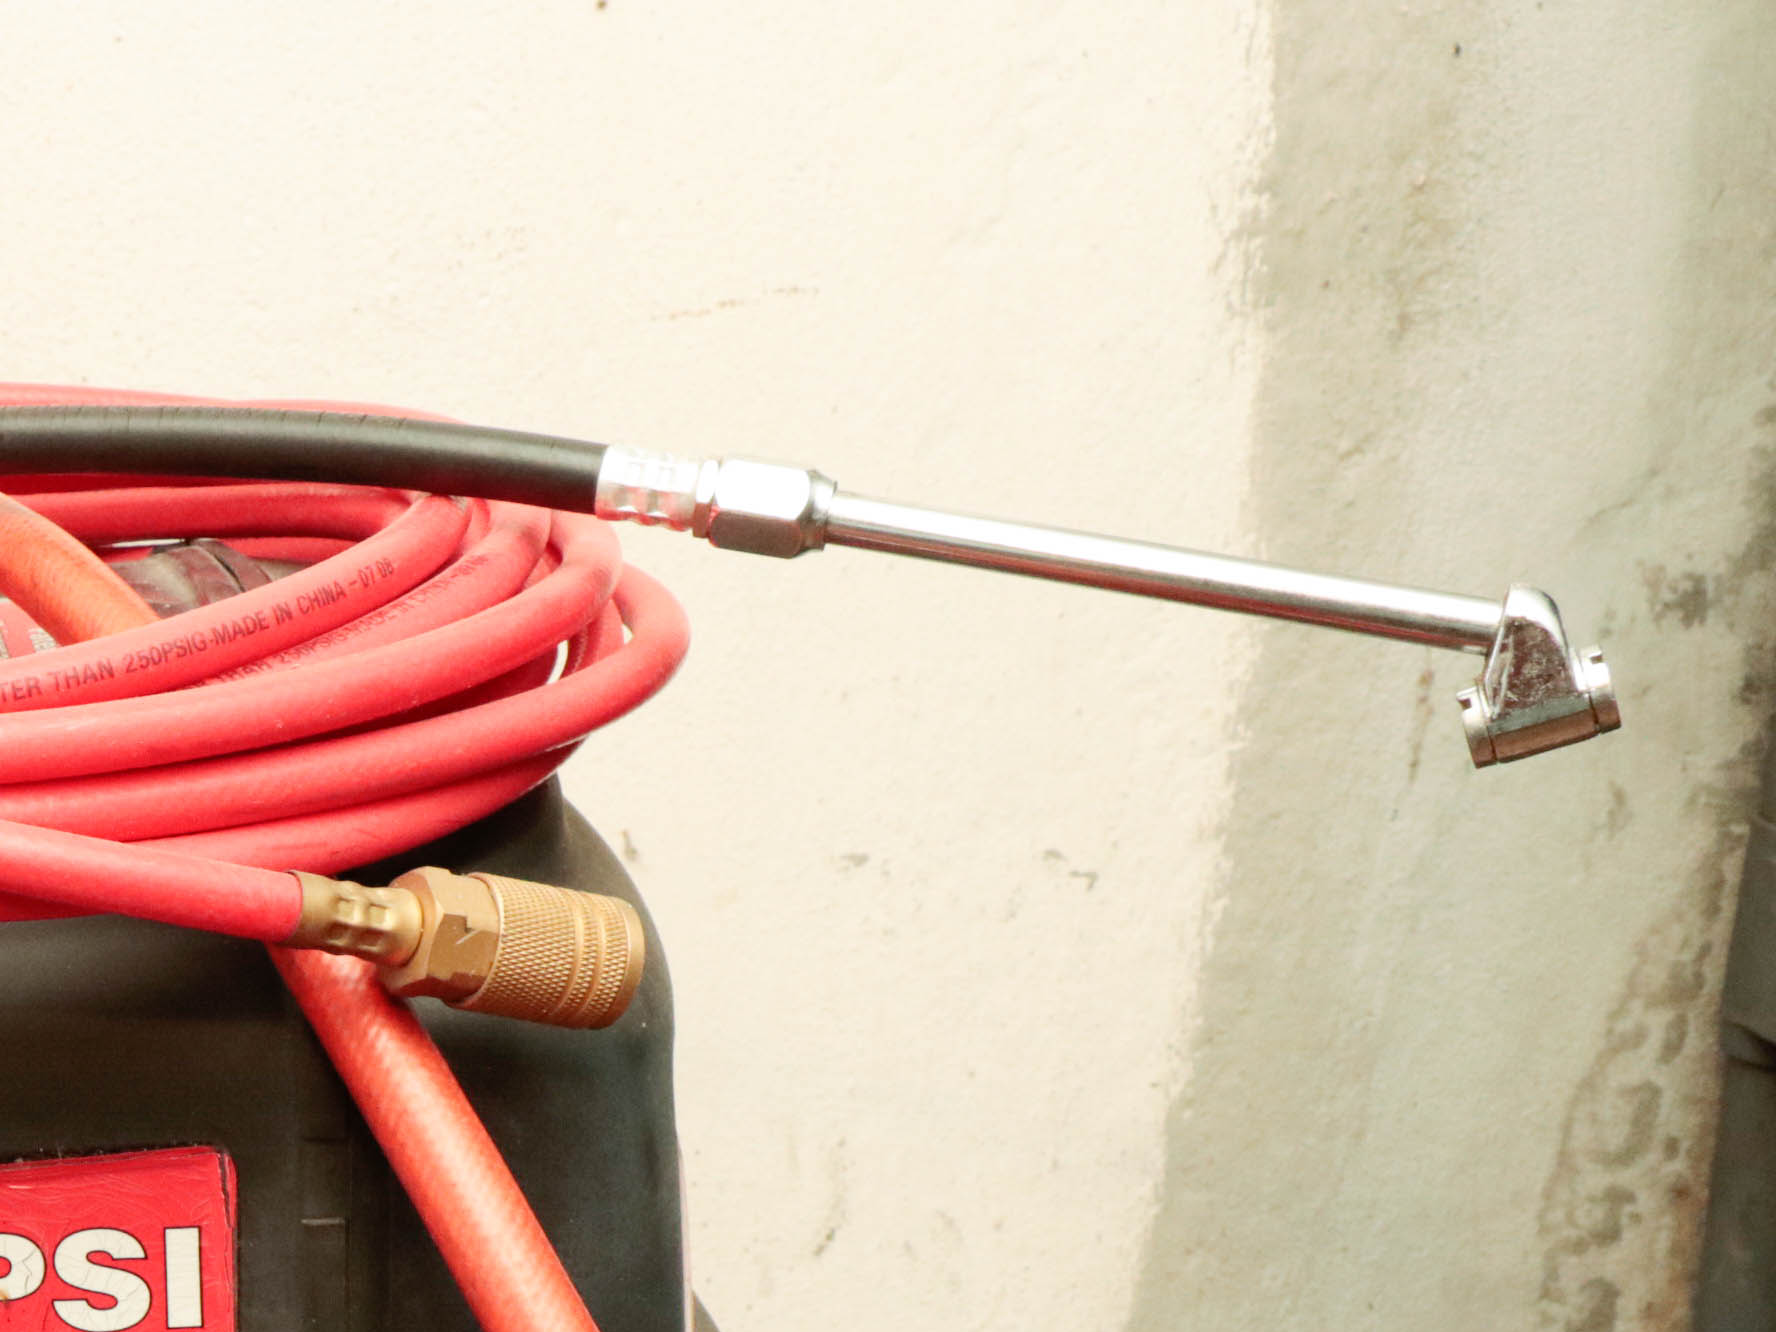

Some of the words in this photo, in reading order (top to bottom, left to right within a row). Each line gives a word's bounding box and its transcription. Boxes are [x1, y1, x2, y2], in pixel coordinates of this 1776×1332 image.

[52, 657, 115, 692] THAN
[273, 601, 293, 625] IN
[296, 580, 347, 616] CHINA
